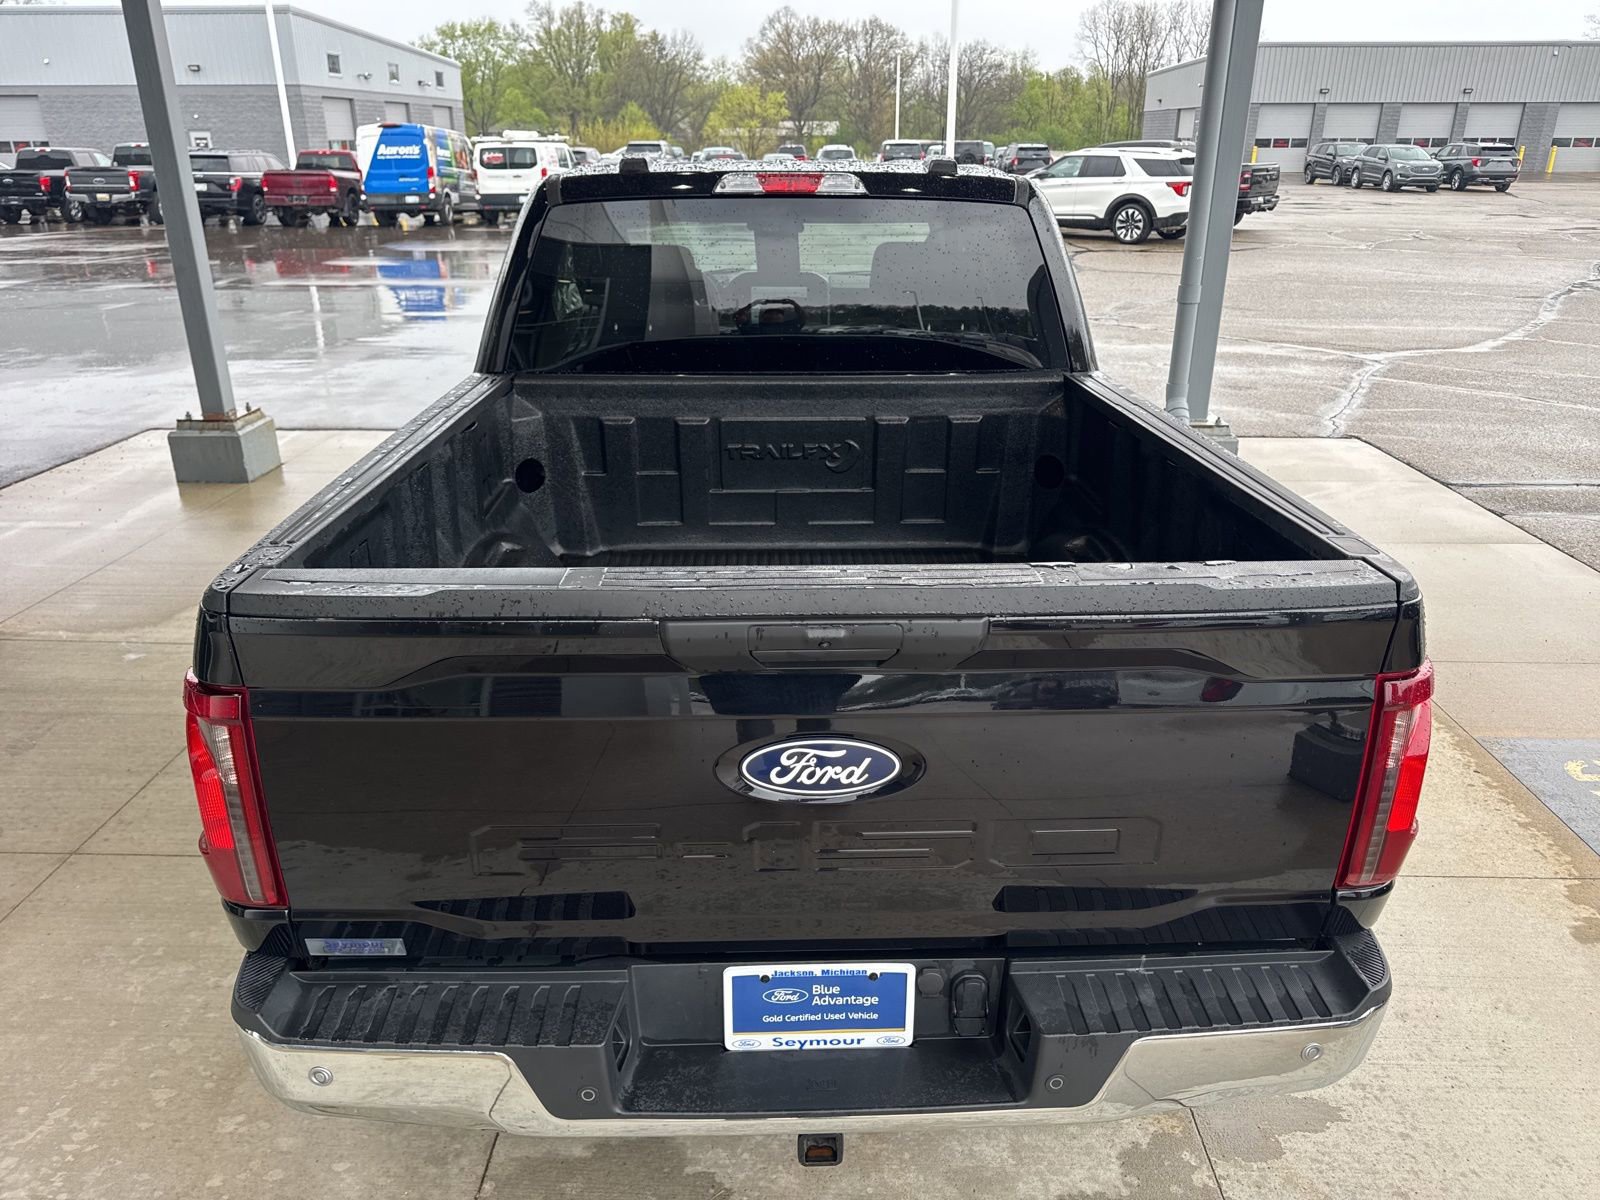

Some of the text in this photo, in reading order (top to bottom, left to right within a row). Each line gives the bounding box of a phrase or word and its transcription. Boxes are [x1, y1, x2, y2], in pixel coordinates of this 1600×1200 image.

[769, 747, 872, 785] Ford
[821, 968, 868, 977] Michigan
[770, 989, 800, 1002] Ford
[812, 984, 841, 995] Blue
[811, 996, 879, 1006] Advantage
[762, 1011, 879, 1023] Gold Certified Used Vehicle
[772, 1037, 865, 1049] Seymour
